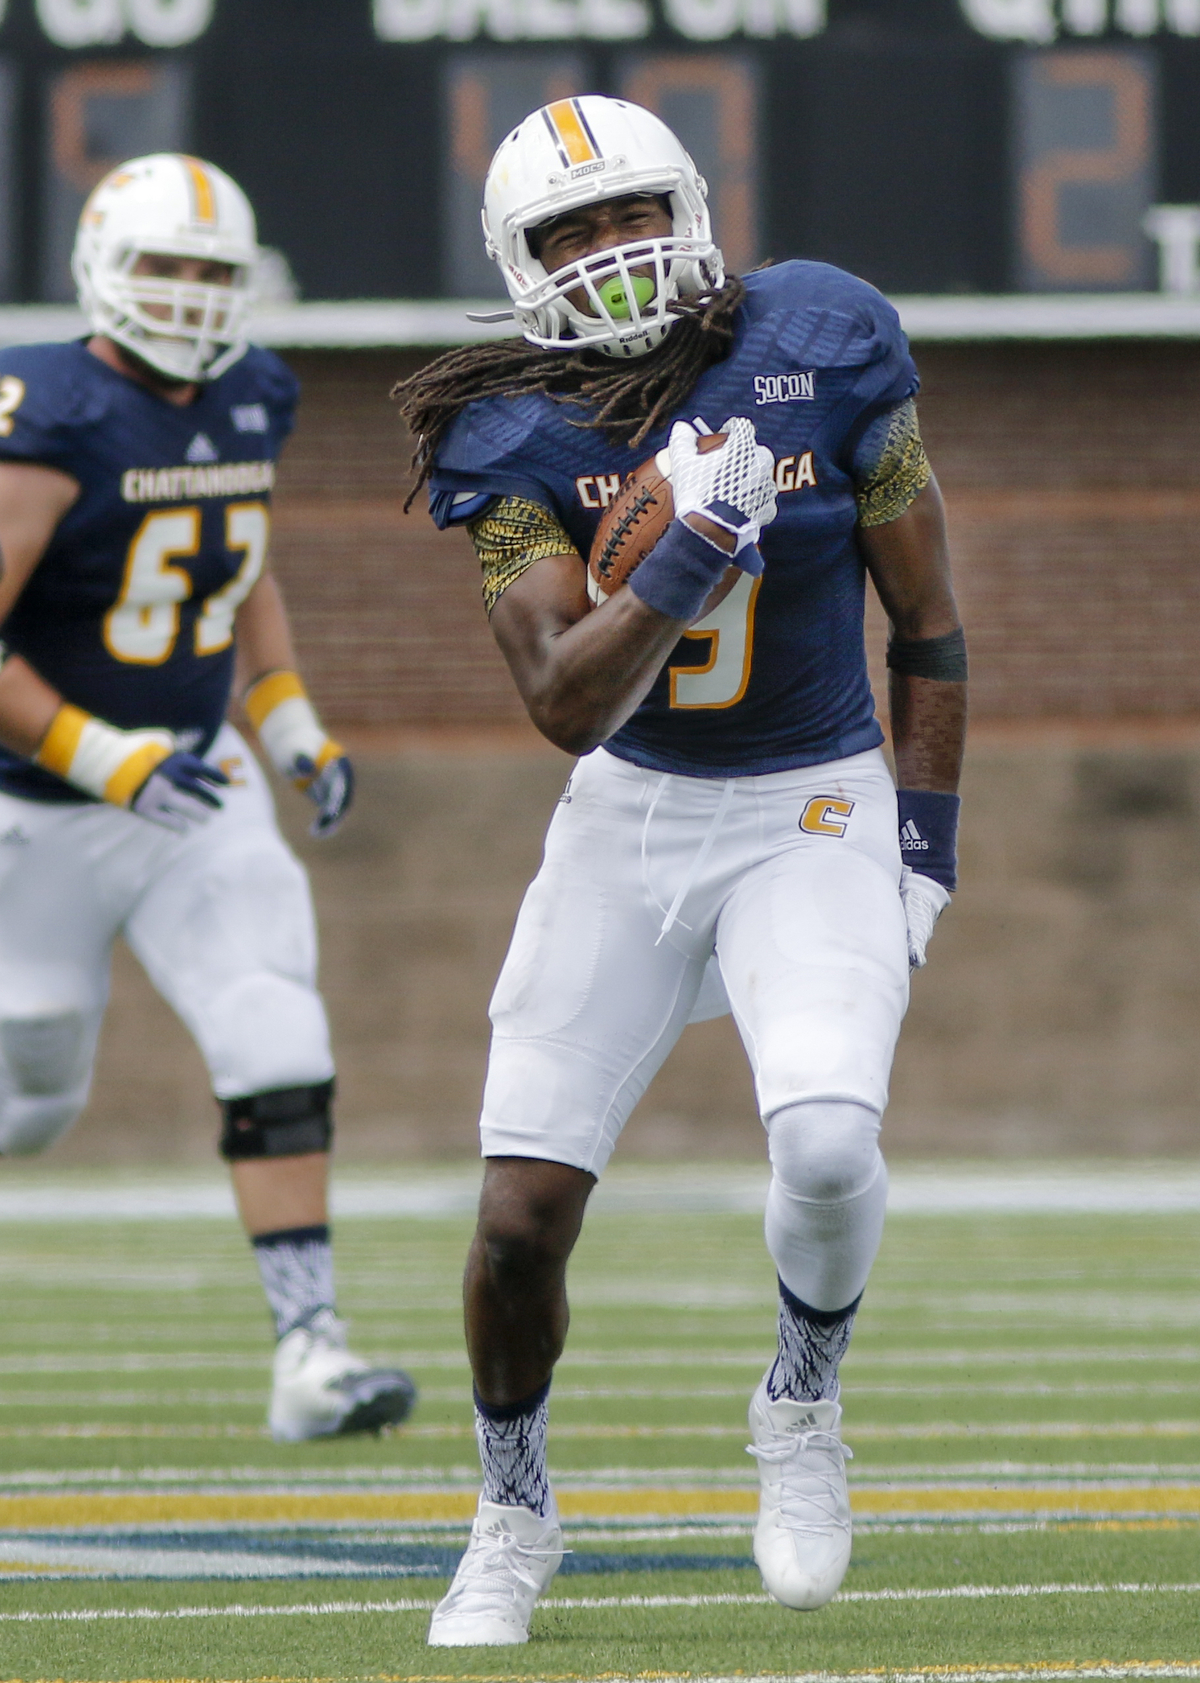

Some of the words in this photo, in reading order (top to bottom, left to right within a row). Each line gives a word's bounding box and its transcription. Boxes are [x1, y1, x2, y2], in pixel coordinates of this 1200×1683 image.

[572, 163, 604, 179] MOCS
[1020, 52, 1150, 287] 2
[753, 371, 815, 406] SOCON
[799, 795, 856, 839] C
